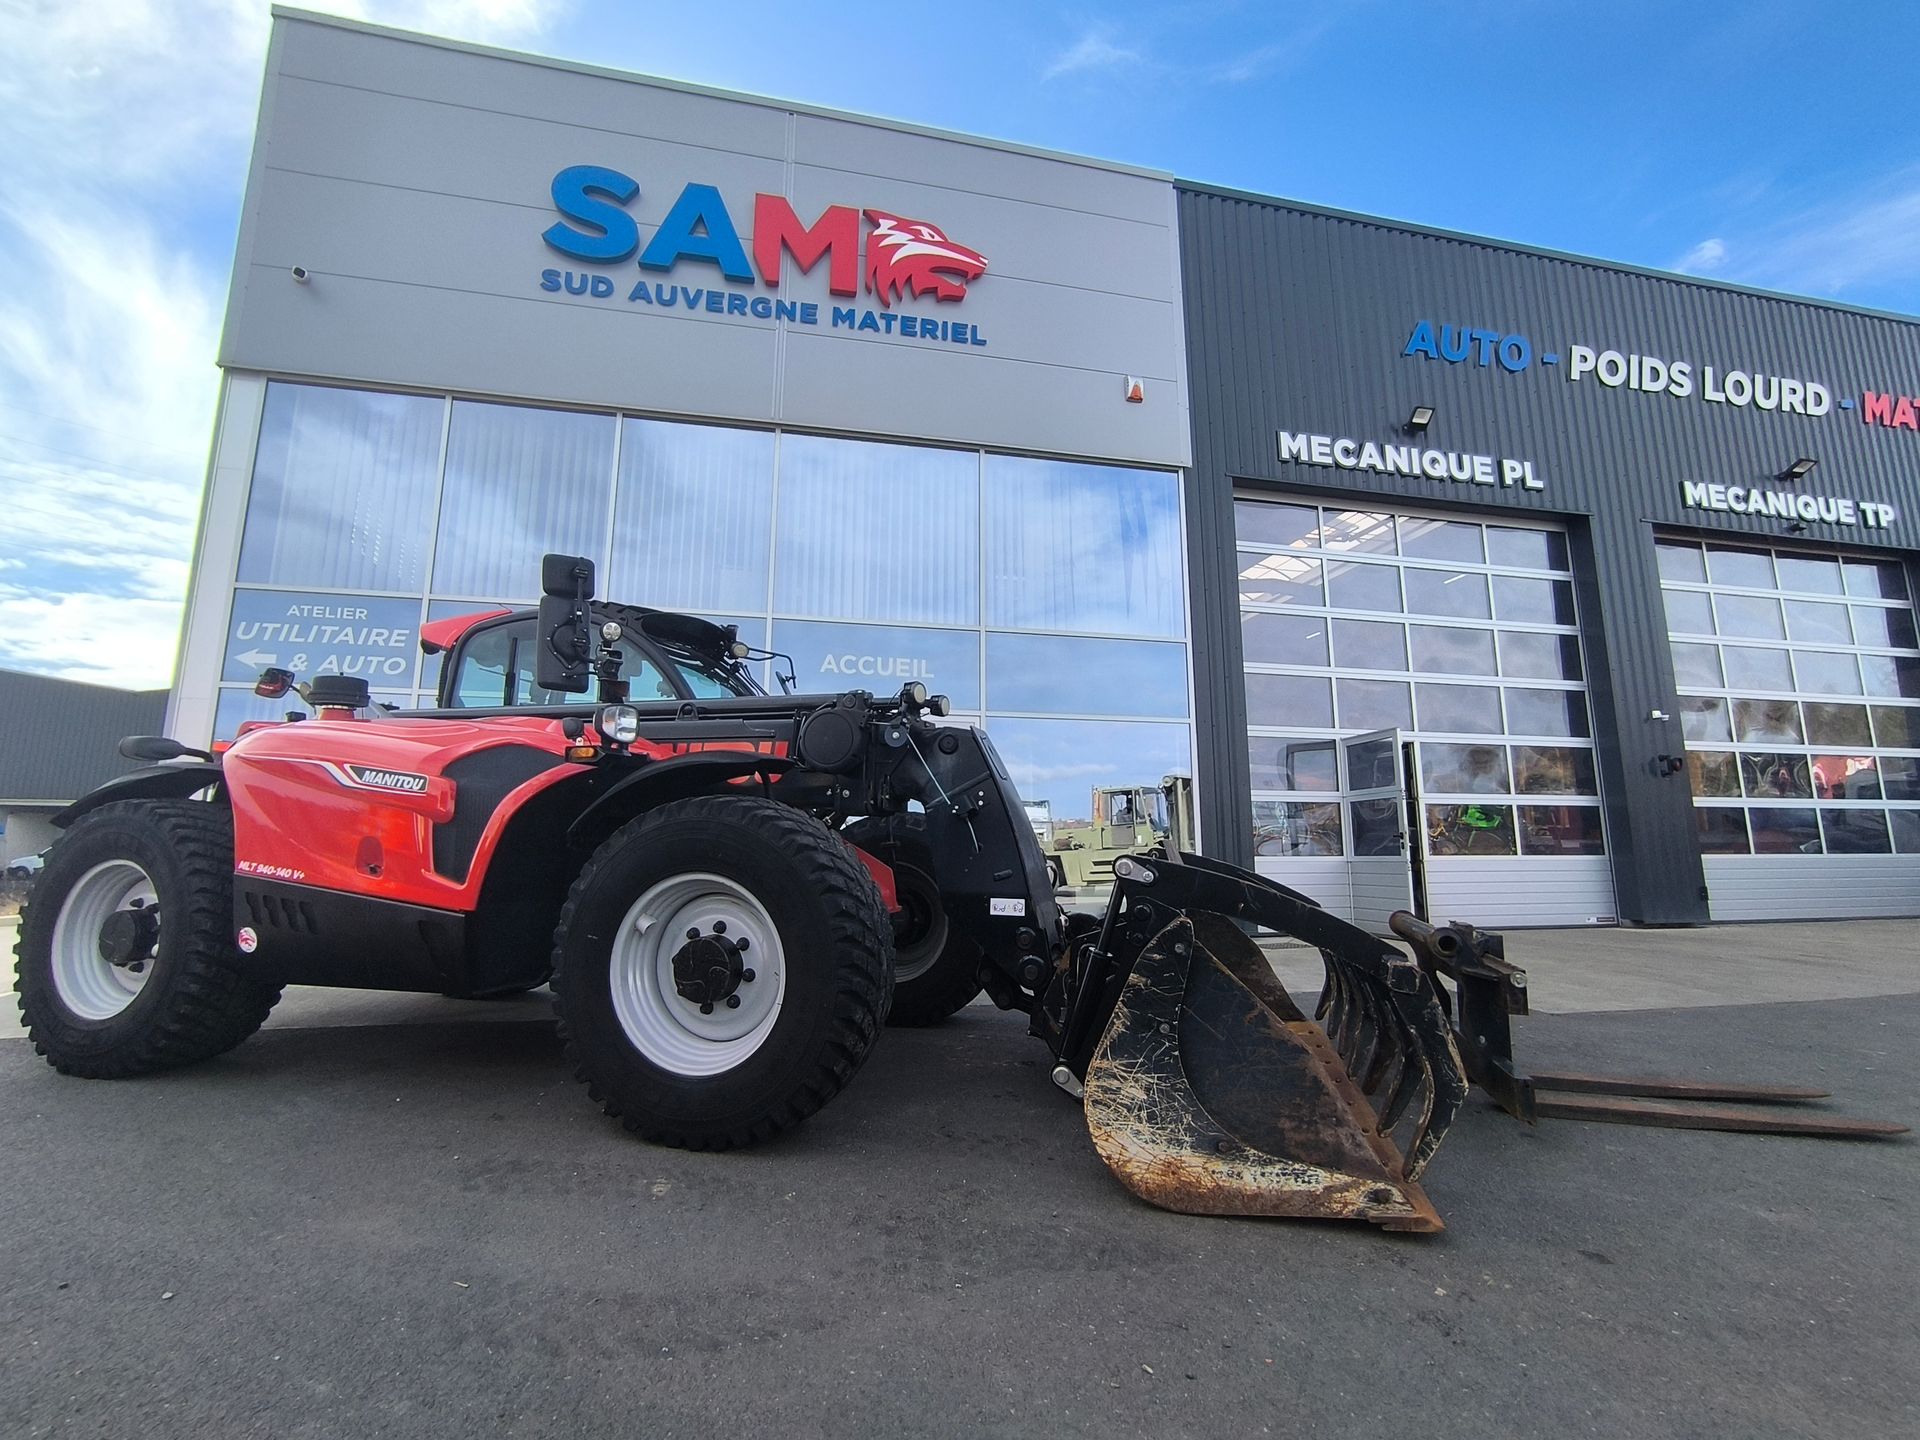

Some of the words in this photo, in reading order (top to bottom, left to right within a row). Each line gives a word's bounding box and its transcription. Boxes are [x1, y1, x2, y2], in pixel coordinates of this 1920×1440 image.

[541, 165, 860, 298] SAM
[540, 268, 614, 298] SUD
[628, 280, 818, 325] AUVERGNE
[831, 306, 987, 346] MATERIEL
[1402, 320, 1532, 372] AUTO
[1570, 345, 1693, 397] POIDS
[1703, 366, 1830, 417] LOURD
[1277, 430, 1495, 486] MECANIQUE
[1502, 459, 1544, 491] PL
[1680, 480, 1856, 525] MECANIQUE
[1858, 502, 1895, 528] TP
[286, 604, 368, 620] ATELIER
[236, 621, 409, 647] UTILITAIRE
[288, 653, 308, 672] &
[316, 654, 407, 675] AUTO
[820, 654, 934, 678] ACCUEIL
[361, 770, 425, 791] MANITOU
[238, 860, 257, 871] MLT
[256, 864, 292, 878] 940-140
